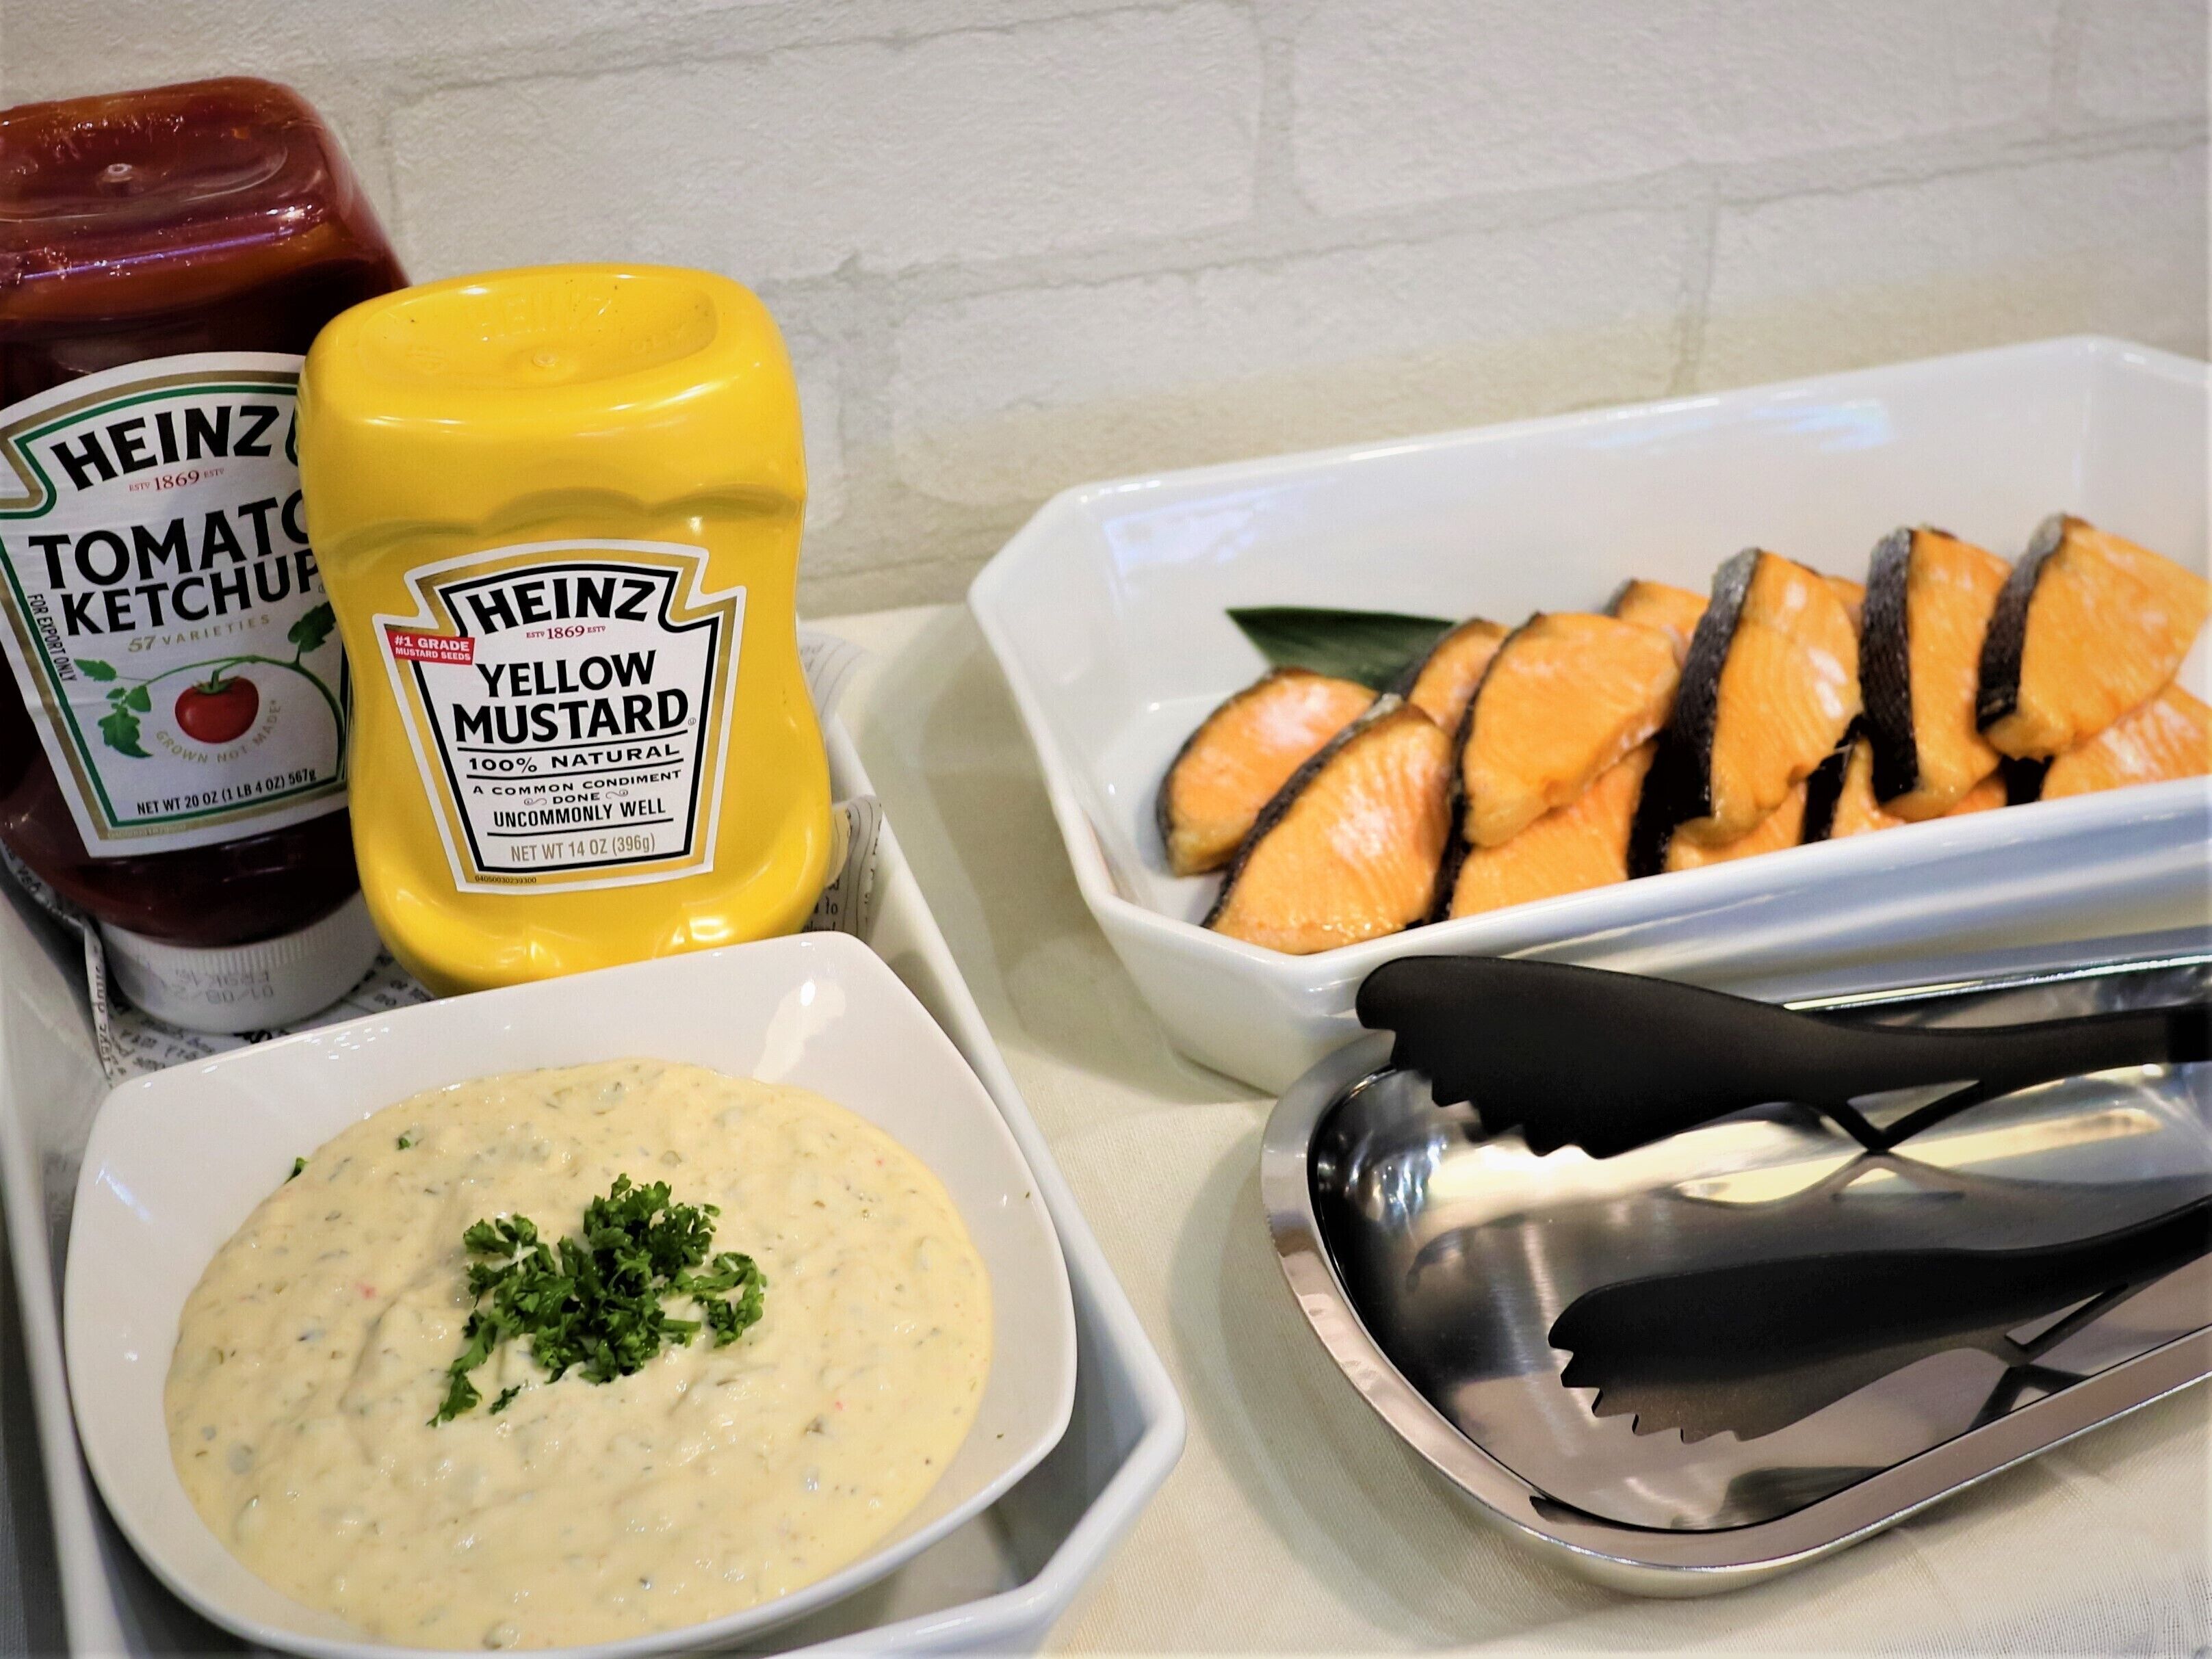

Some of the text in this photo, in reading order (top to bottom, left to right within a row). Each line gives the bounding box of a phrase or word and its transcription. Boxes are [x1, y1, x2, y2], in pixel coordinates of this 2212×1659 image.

[50, 405, 281, 491] HEINZ
[154, 469, 200, 491] 1869
[60, 547, 320, 636] KETCHUP
[465, 577, 657, 635] HEINZ
[27, 594, 77, 681] FOR EXPORT ONLY
[127, 614, 270, 653] 57 VARIETIES
[393, 635, 470, 652] #1 GRADE
[547, 625, 585, 640] 1869
[395, 646, 471, 661] MUSTARD SEEDS
[473, 649, 657, 698] YELLOW
[452, 687, 689, 744] MUSTARD
[155, 730, 209, 763] GROWN
[216, 745, 248, 763] NOT
[469, 742, 680, 774] 100% NATURAL
[137, 768, 317, 816] NET WT 20 OZ (1 LB 4 OZ) 567g
[473, 770, 682, 796] A COMMON CONDIMENT
[552, 792, 601, 805] DONE
[493, 797, 666, 828] UNCOMMONLY WELL
[510, 832, 656, 863] NET WT 14 OZ (396g)
